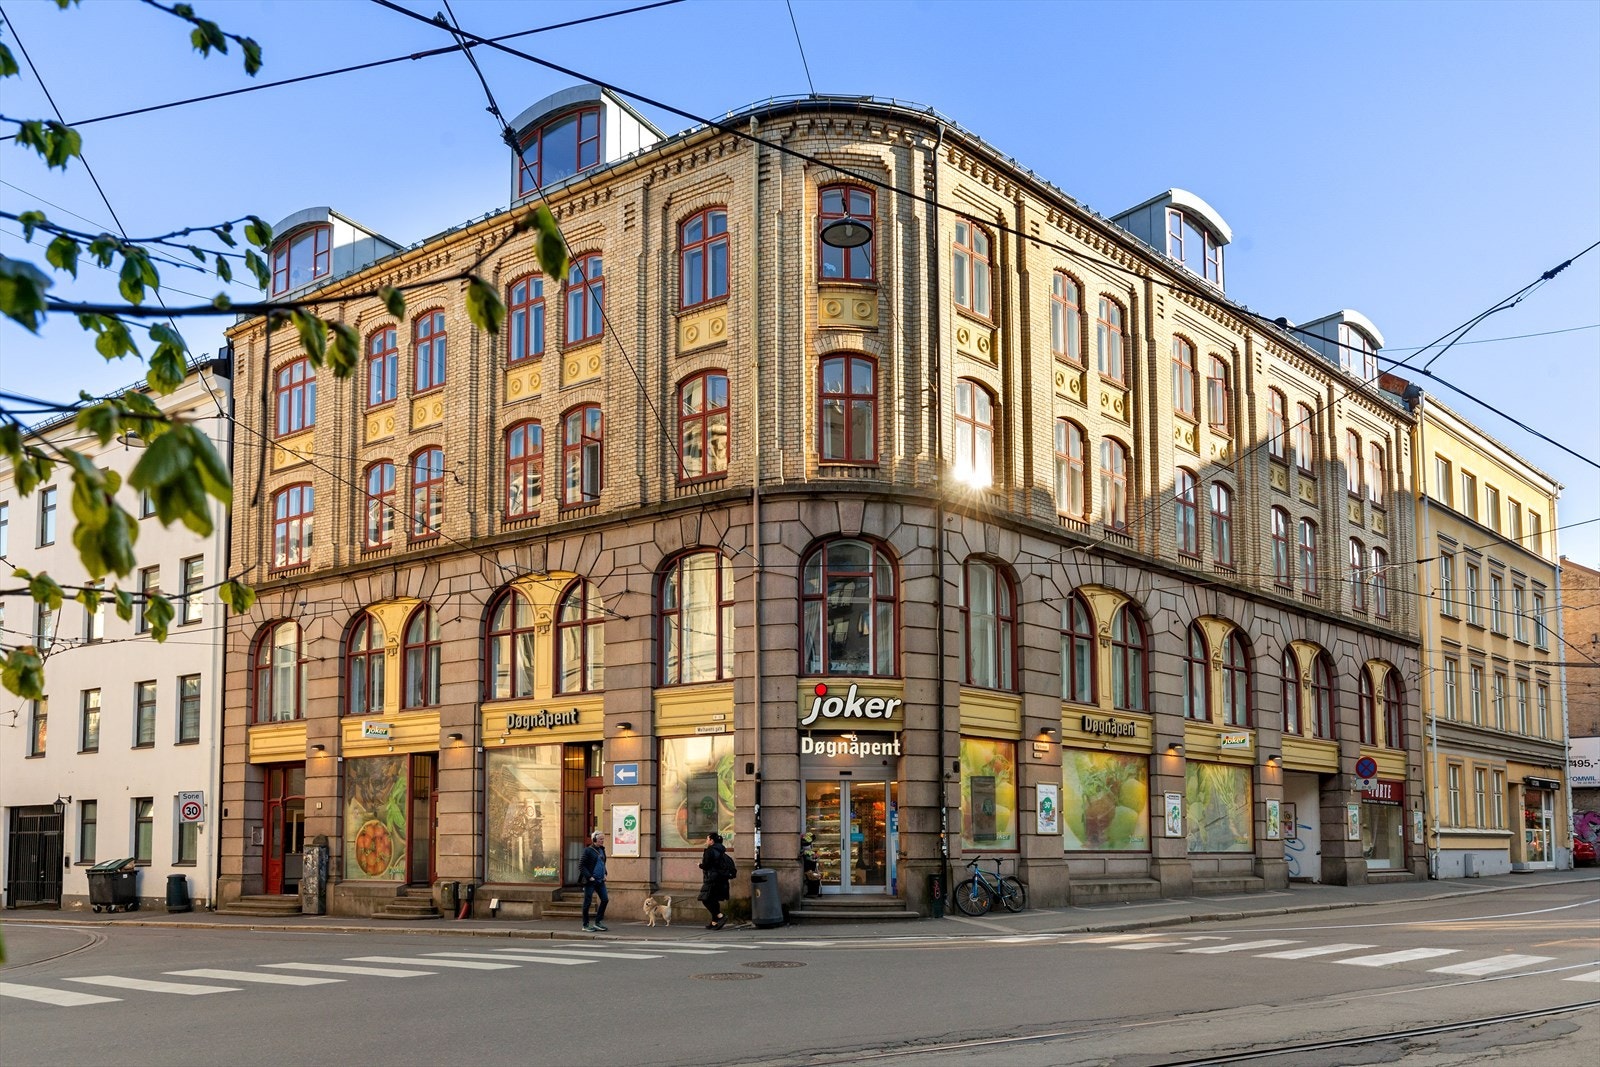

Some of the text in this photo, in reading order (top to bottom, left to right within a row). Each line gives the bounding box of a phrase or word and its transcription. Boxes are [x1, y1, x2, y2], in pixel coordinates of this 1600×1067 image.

[801, 683, 902, 726] joker
[507, 708, 578, 730] Døgnåpent
[1083, 715, 1137, 737] Døgnåpent
[365, 725, 388, 736] joker
[1223, 735, 1247, 746] joker
[801, 735, 901, 758] Døgnåpent
[186, 806, 198, 816] 30
